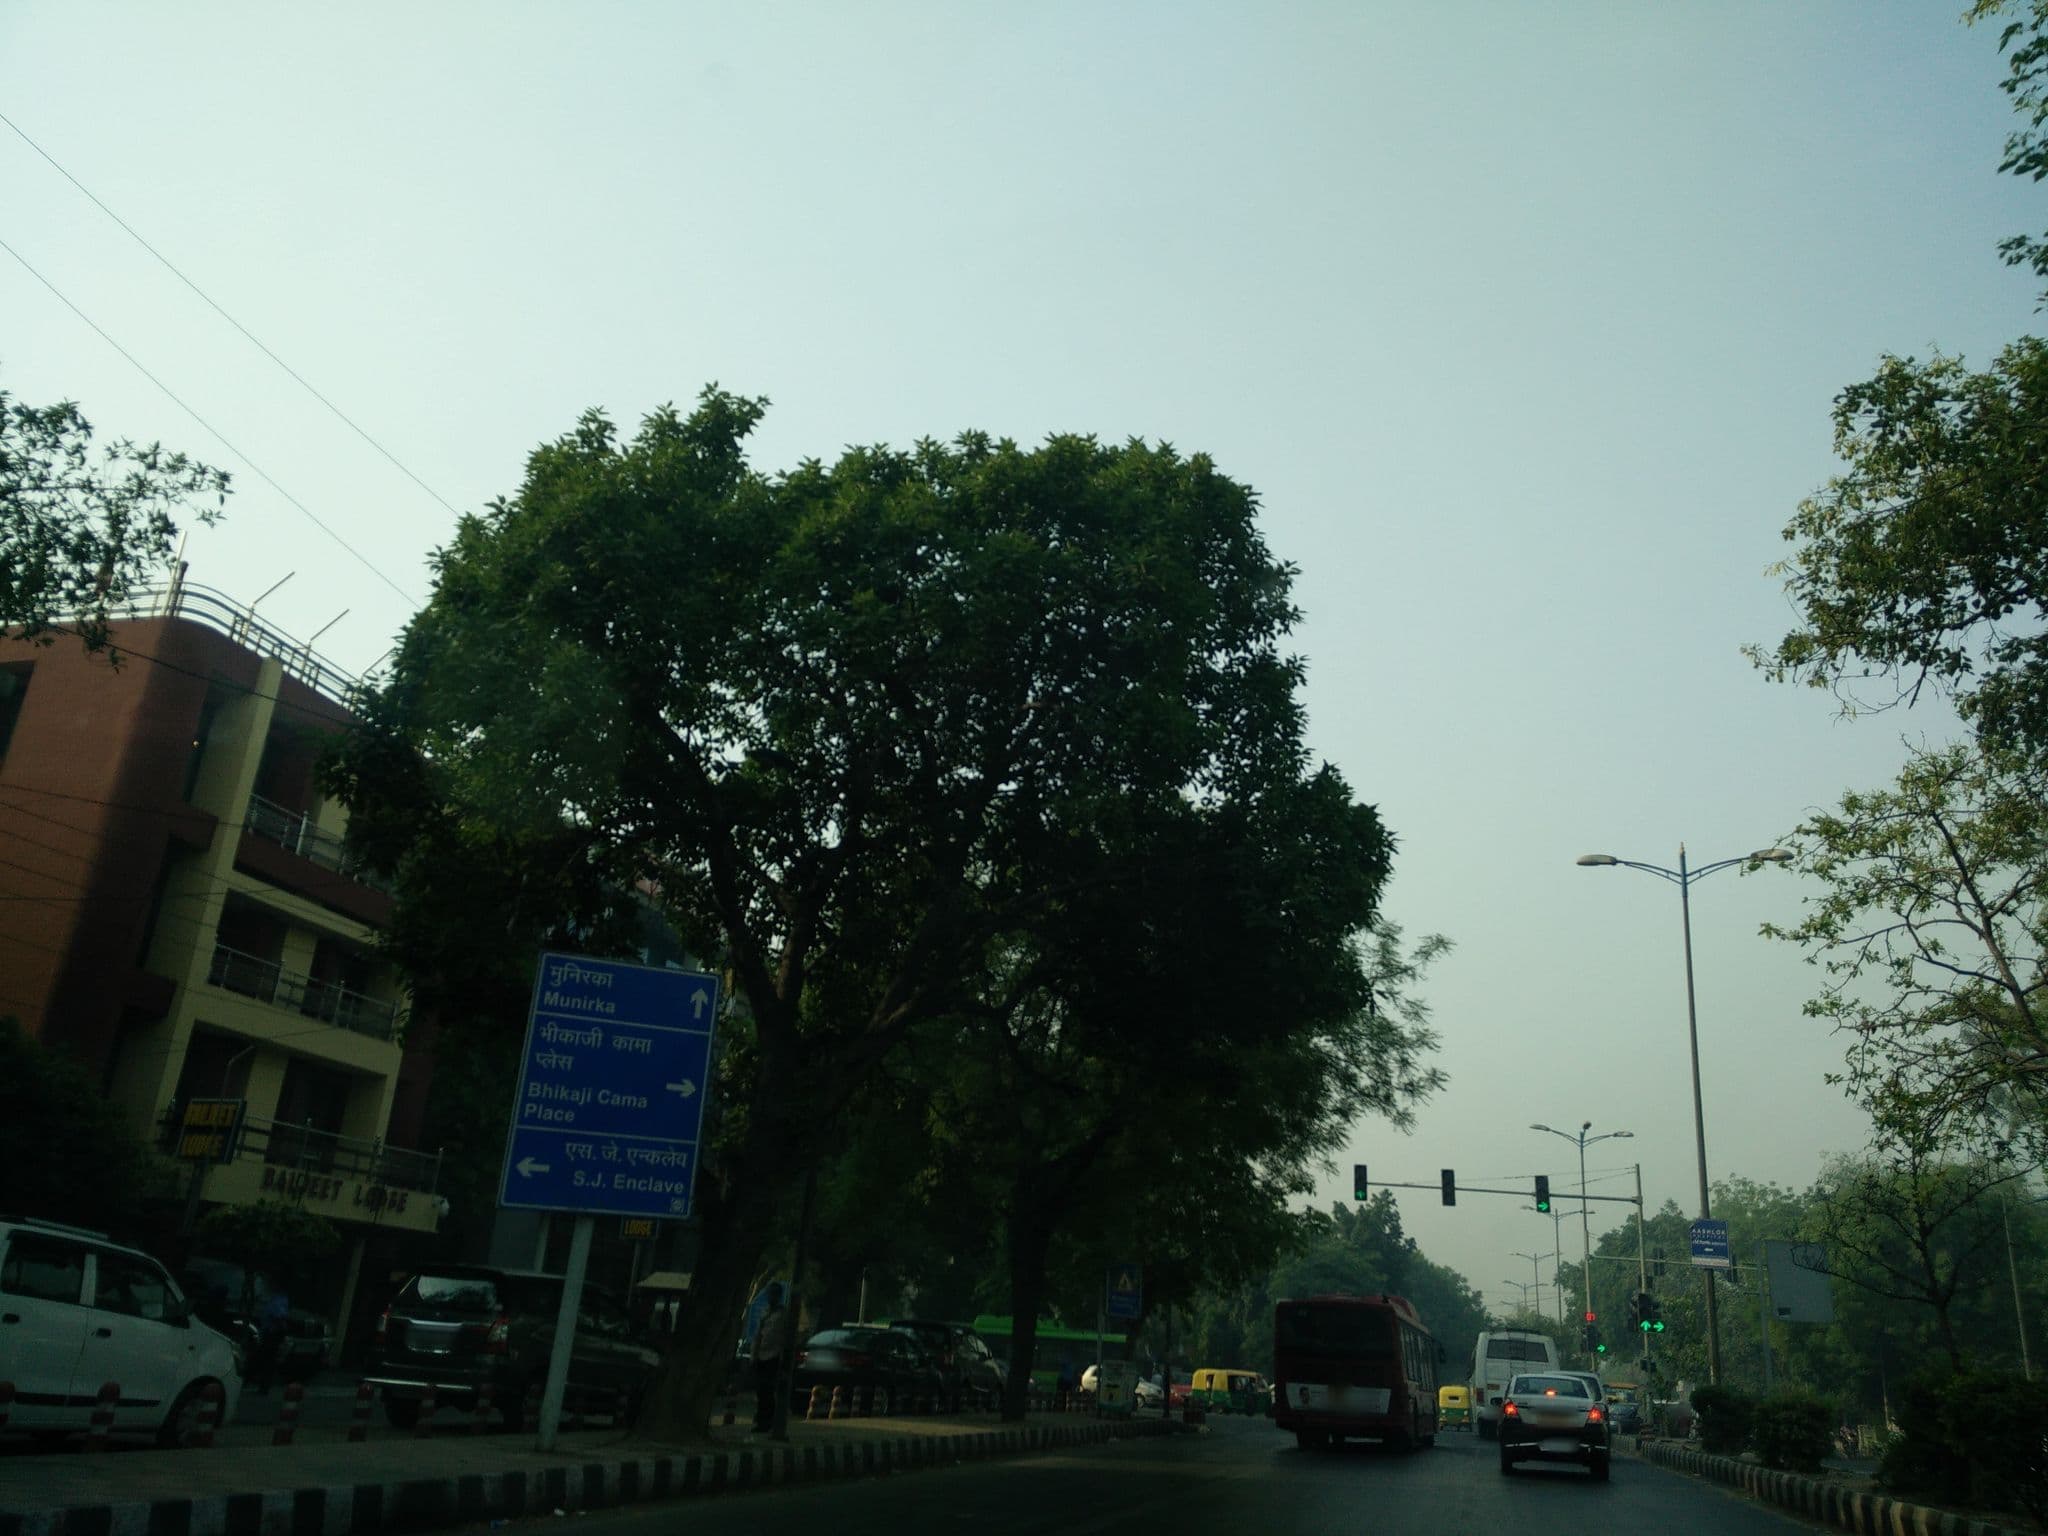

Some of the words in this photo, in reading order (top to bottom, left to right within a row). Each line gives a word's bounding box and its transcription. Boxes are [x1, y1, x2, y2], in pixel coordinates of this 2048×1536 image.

[550, 962, 615, 989] मुनिरका
[543, 990, 616, 1014] Munirka
[539, 1021, 603, 1048] भीकाजी
[612, 1034, 652, 1055] कामा
[534, 1049, 575, 1071] प्लेस
[528, 1081, 592, 1106] Bhikaji
[598, 1089, 648, 1109] Cama
[524, 1103, 576, 1122] Place
[573, 1169, 606, 1190] S.J.
[613, 1173, 685, 1195] Enclave
